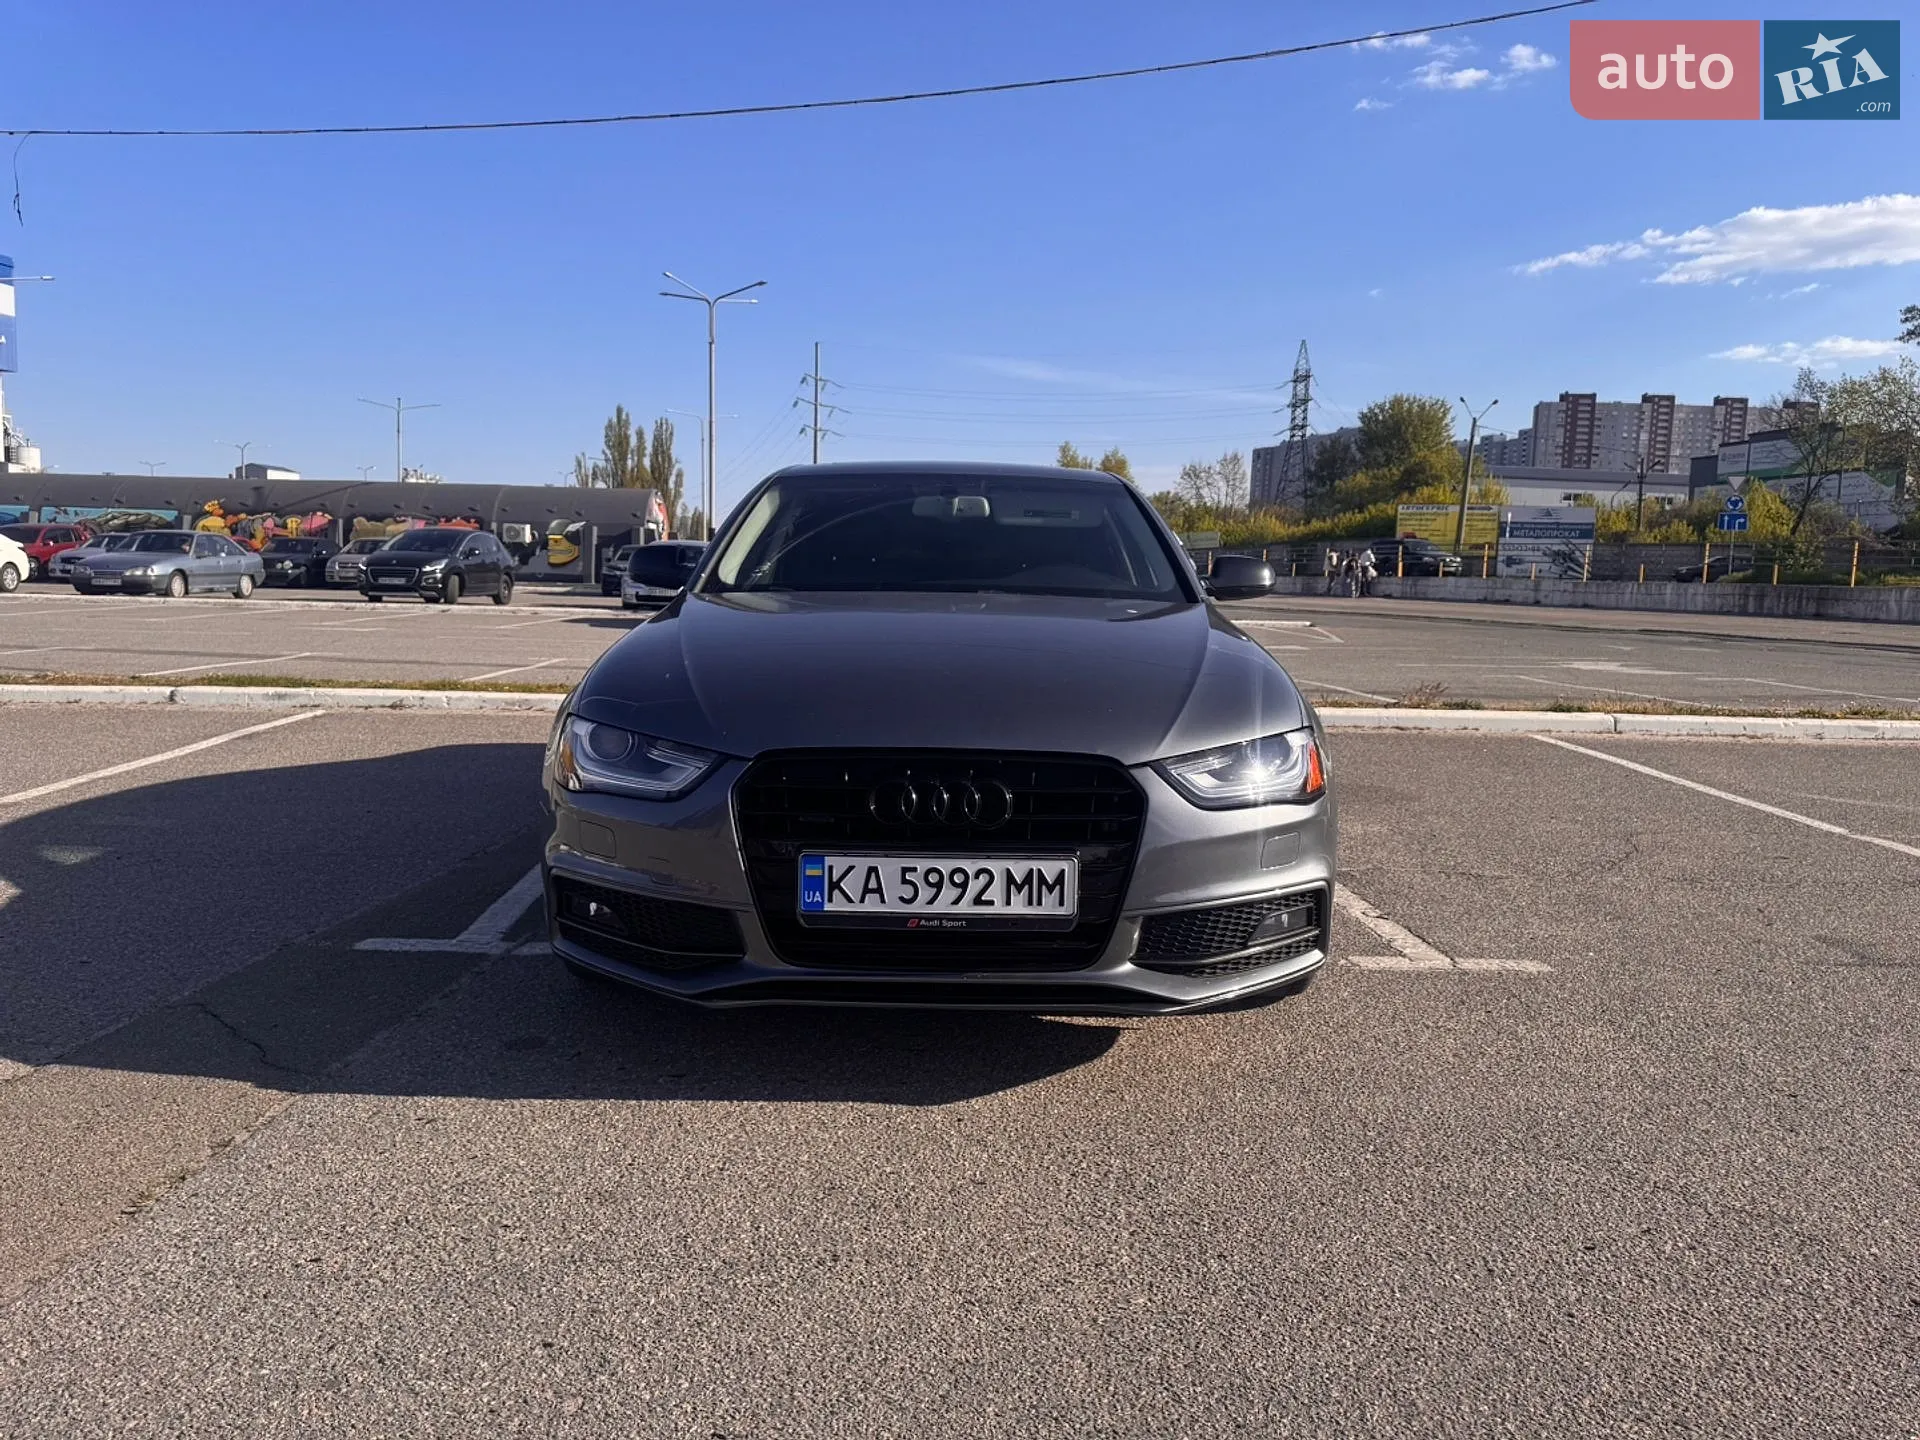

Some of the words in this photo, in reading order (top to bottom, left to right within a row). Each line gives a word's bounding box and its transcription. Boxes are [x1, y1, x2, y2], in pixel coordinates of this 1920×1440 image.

[827, 865, 886, 904] KA
[898, 866, 996, 906] 5992
[1005, 867, 1066, 907] MM
[805, 891, 822, 903] UA
[919, 919, 940, 928] Audi
[942, 919, 967, 929] Sport
